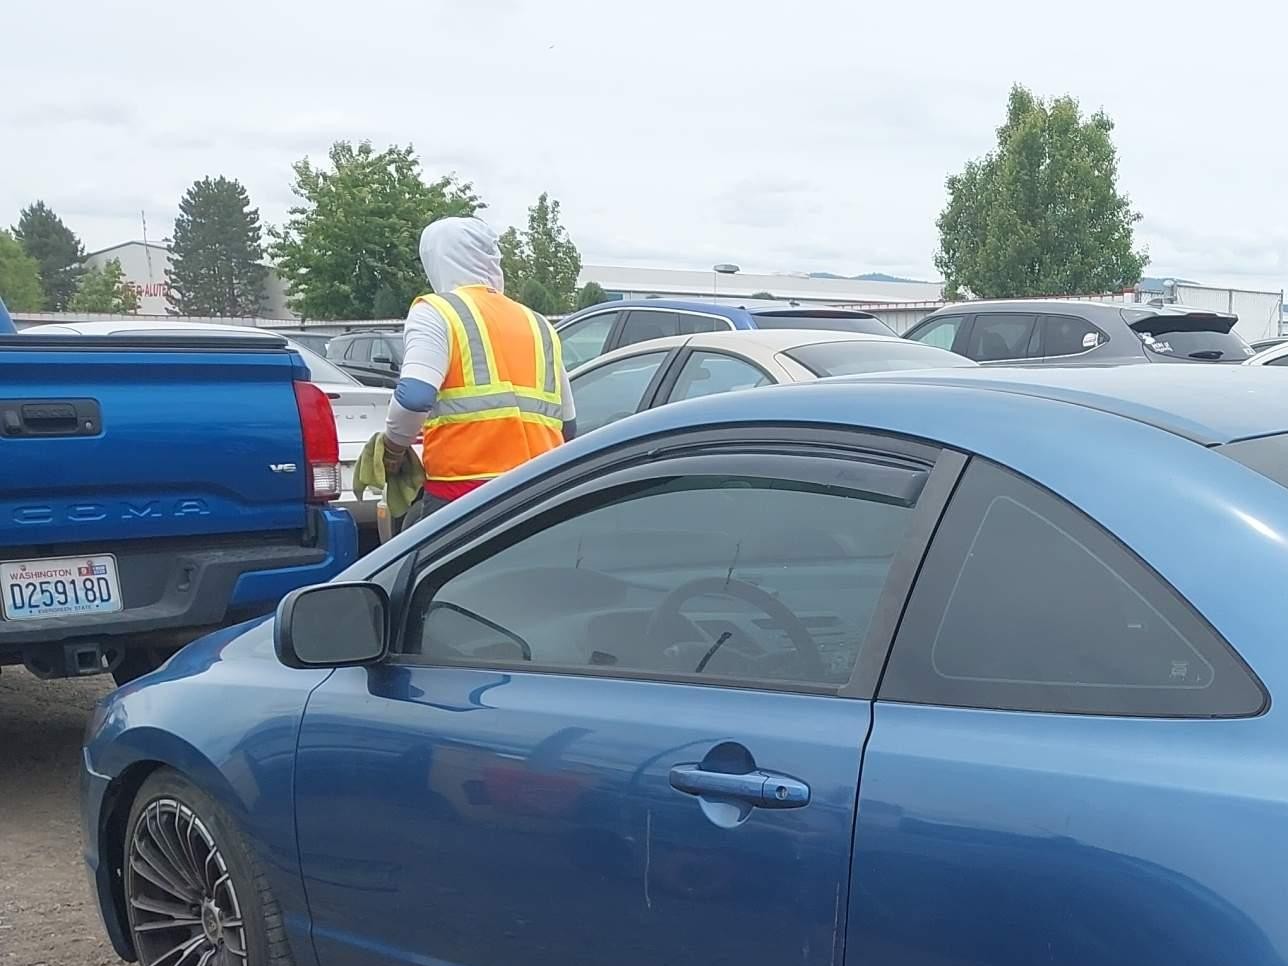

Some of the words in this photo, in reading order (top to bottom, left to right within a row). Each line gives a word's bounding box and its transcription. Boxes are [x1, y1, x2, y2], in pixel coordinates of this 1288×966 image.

[269, 463, 297, 472] V6
[13, 498, 210, 524] COMA
[9, 568, 72, 580] WASHINGTON
[10, 577, 112, 610] D25918D
